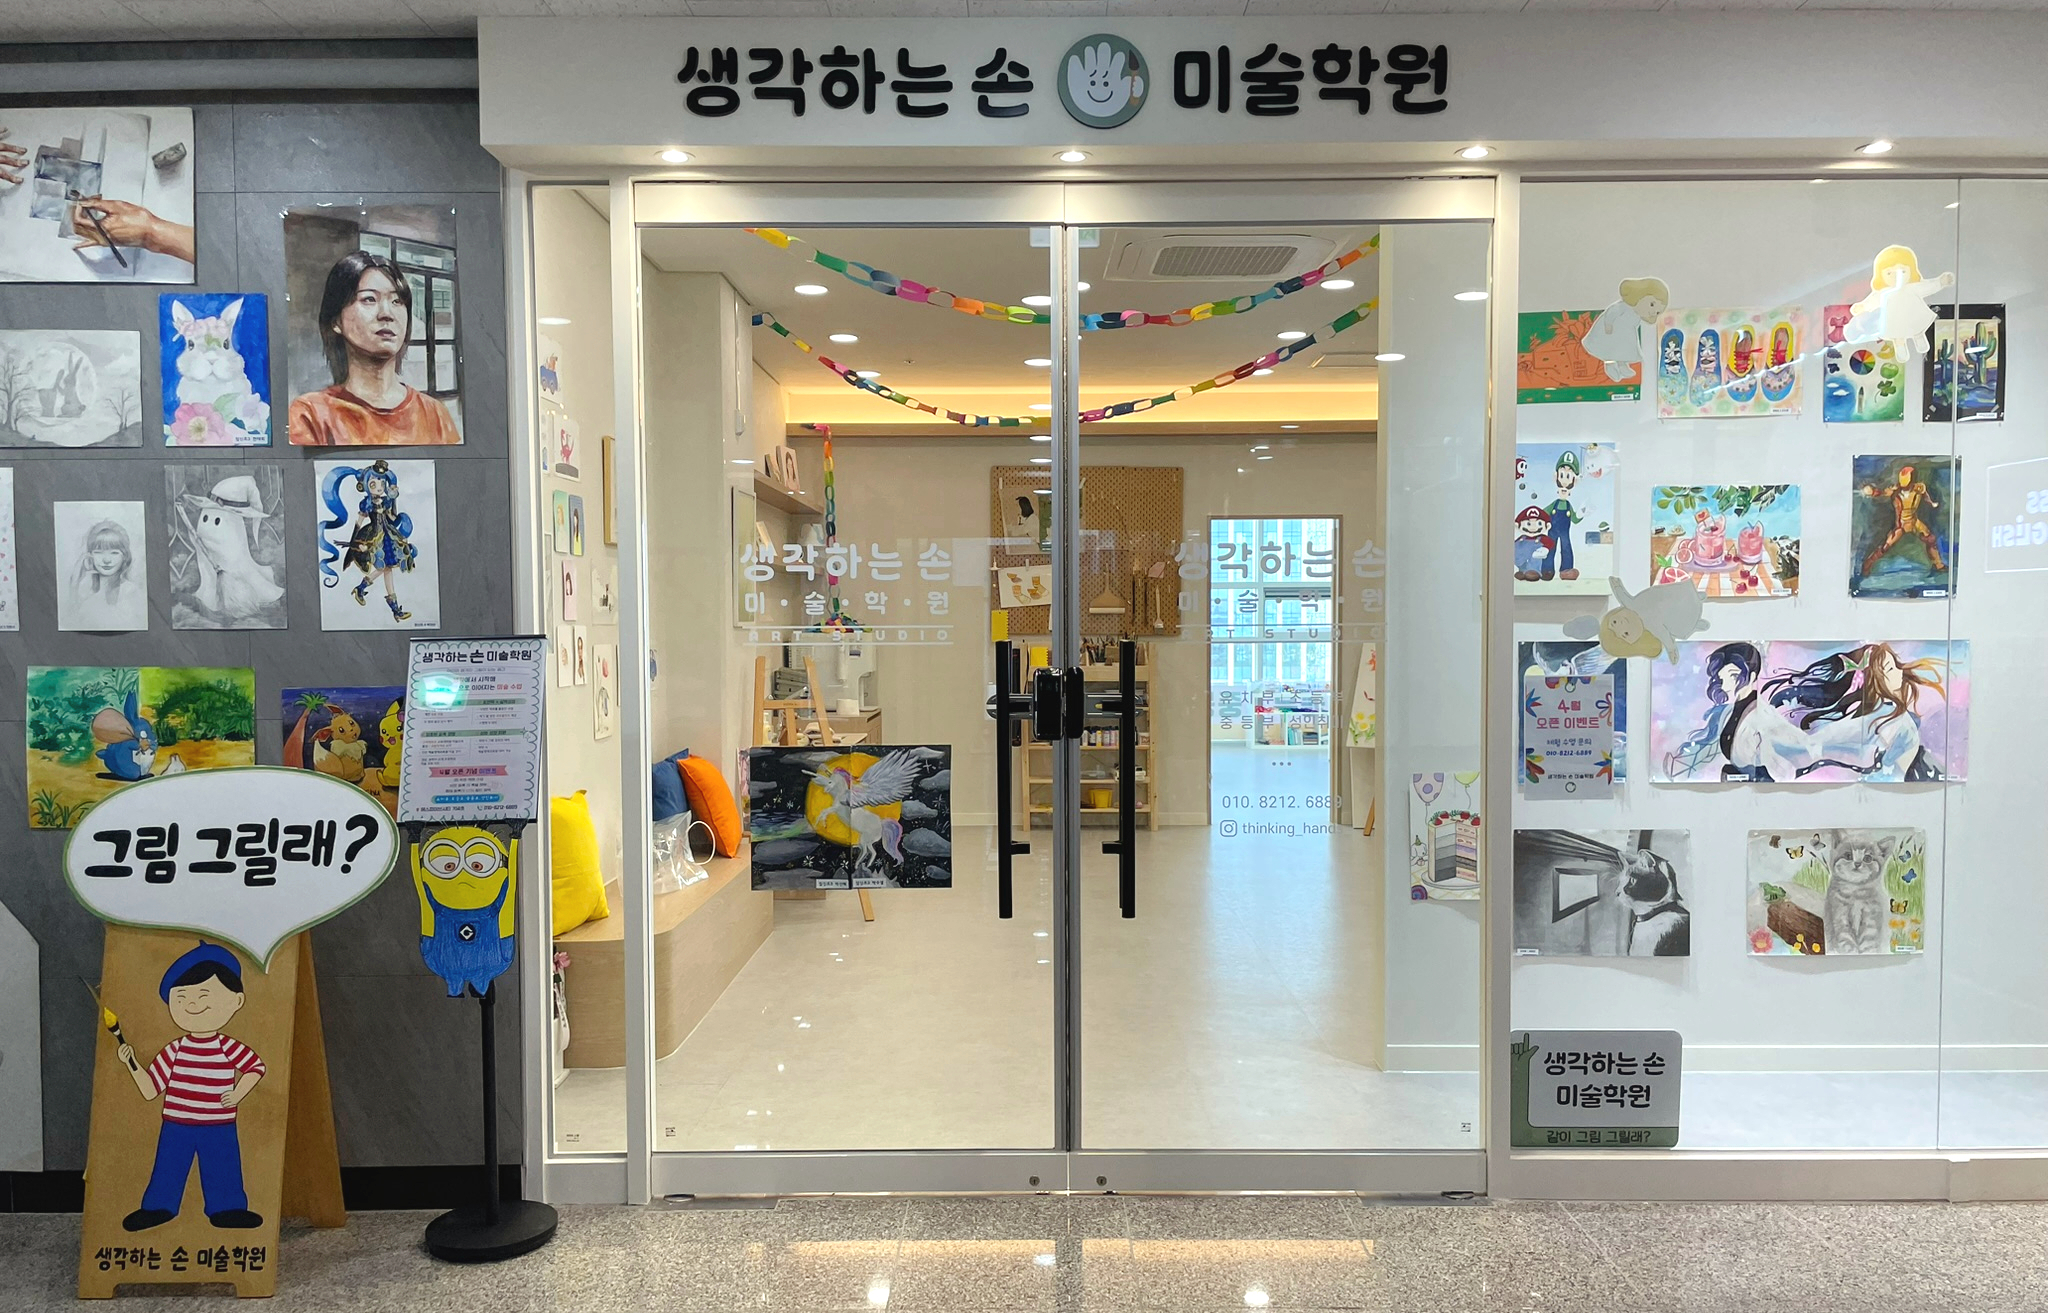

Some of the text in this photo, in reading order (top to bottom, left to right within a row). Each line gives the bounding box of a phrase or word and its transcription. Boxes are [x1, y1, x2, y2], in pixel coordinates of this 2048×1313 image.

[677, 43, 1449, 117] 생각하는 손 미술학원
[740, 543, 952, 582] 생각하는 손
[1175, 539, 1385, 580] 생각하는 손
[750, 630, 948, 642] ART STUDIO
[422, 649, 532, 664] 생각하는 손 미술학원
[1558, 699, 1581, 713] 4월
[1536, 717, 1600, 729] 오픈 이벤트
[1259, 795, 1300, 809] 8212.
[84, 813, 380, 887] 그림 그릴래?
[1543, 1051, 1666, 1076] 생각하는 손
[1556, 1084, 1651, 1109] 미술학원
[1575, 1130, 1602, 1143] 그림
[1605, 1130, 1652, 1144] 그릴래?
[95, 1245, 267, 1273] 생각하는 손 미술학원
